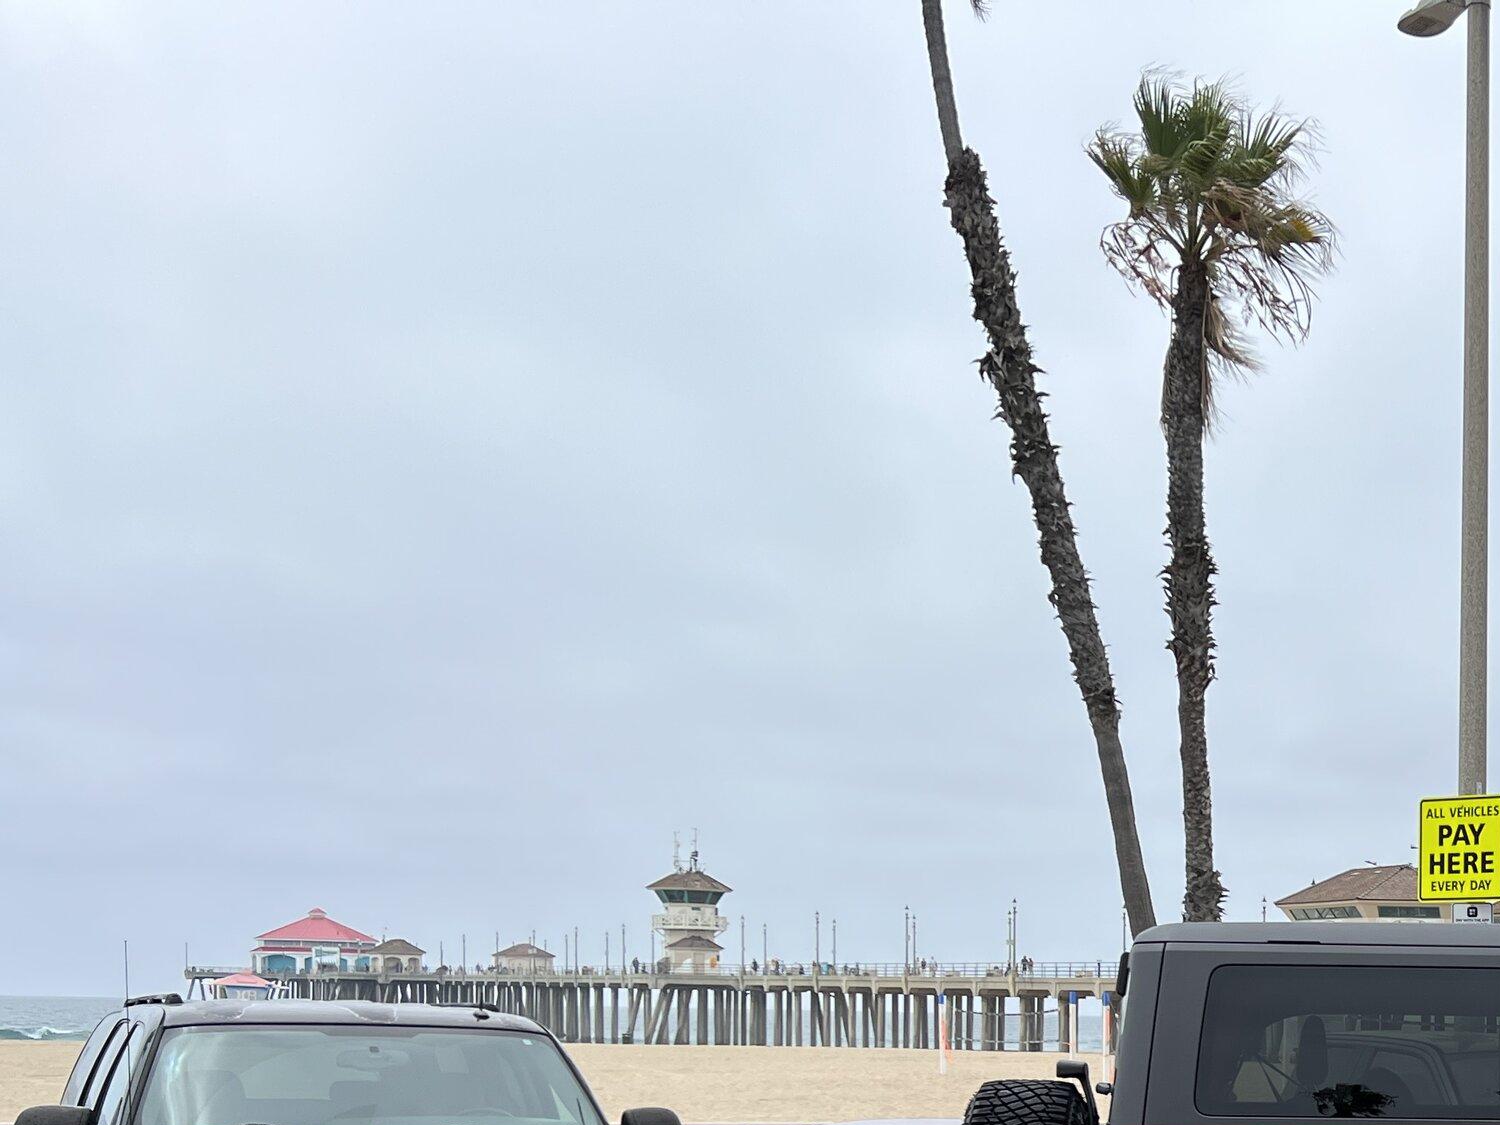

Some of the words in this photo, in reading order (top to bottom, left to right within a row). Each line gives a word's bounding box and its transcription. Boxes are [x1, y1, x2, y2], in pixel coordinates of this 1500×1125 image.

[1426, 808, 1445, 819] ALL
[1449, 805, 1499, 818] VEHICLES
[1438, 823, 1486, 847] PAY
[1429, 851, 1495, 875] HERE
[1431, 880, 1465, 892] EVERY
[1470, 879, 1492, 891] DAY
